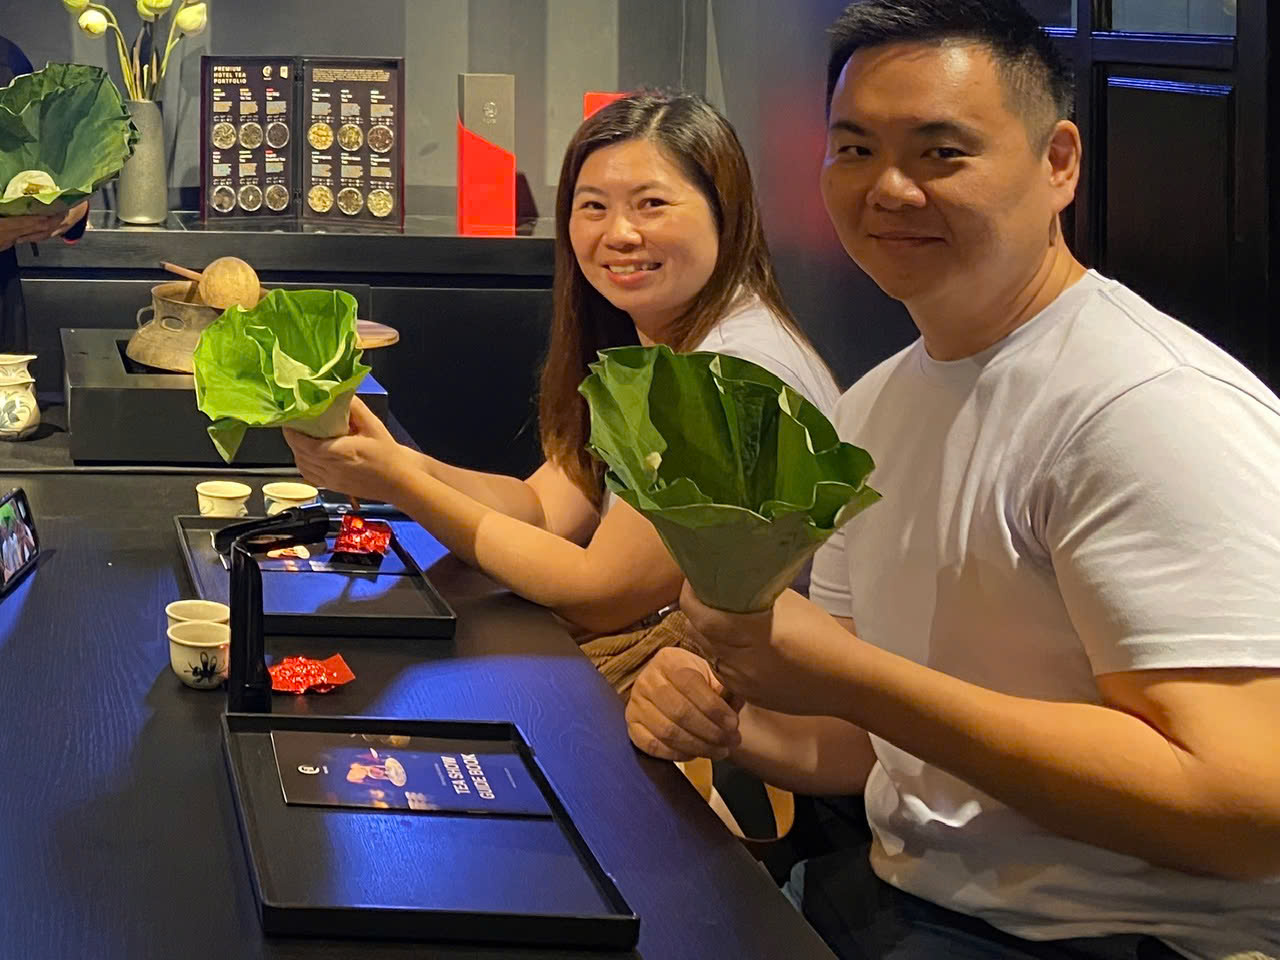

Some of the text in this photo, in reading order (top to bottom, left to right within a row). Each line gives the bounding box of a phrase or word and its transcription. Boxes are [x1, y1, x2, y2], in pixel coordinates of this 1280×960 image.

[441, 755, 471, 794] TEA SHOW
[461, 753, 495, 800] GUIDE BOOK
